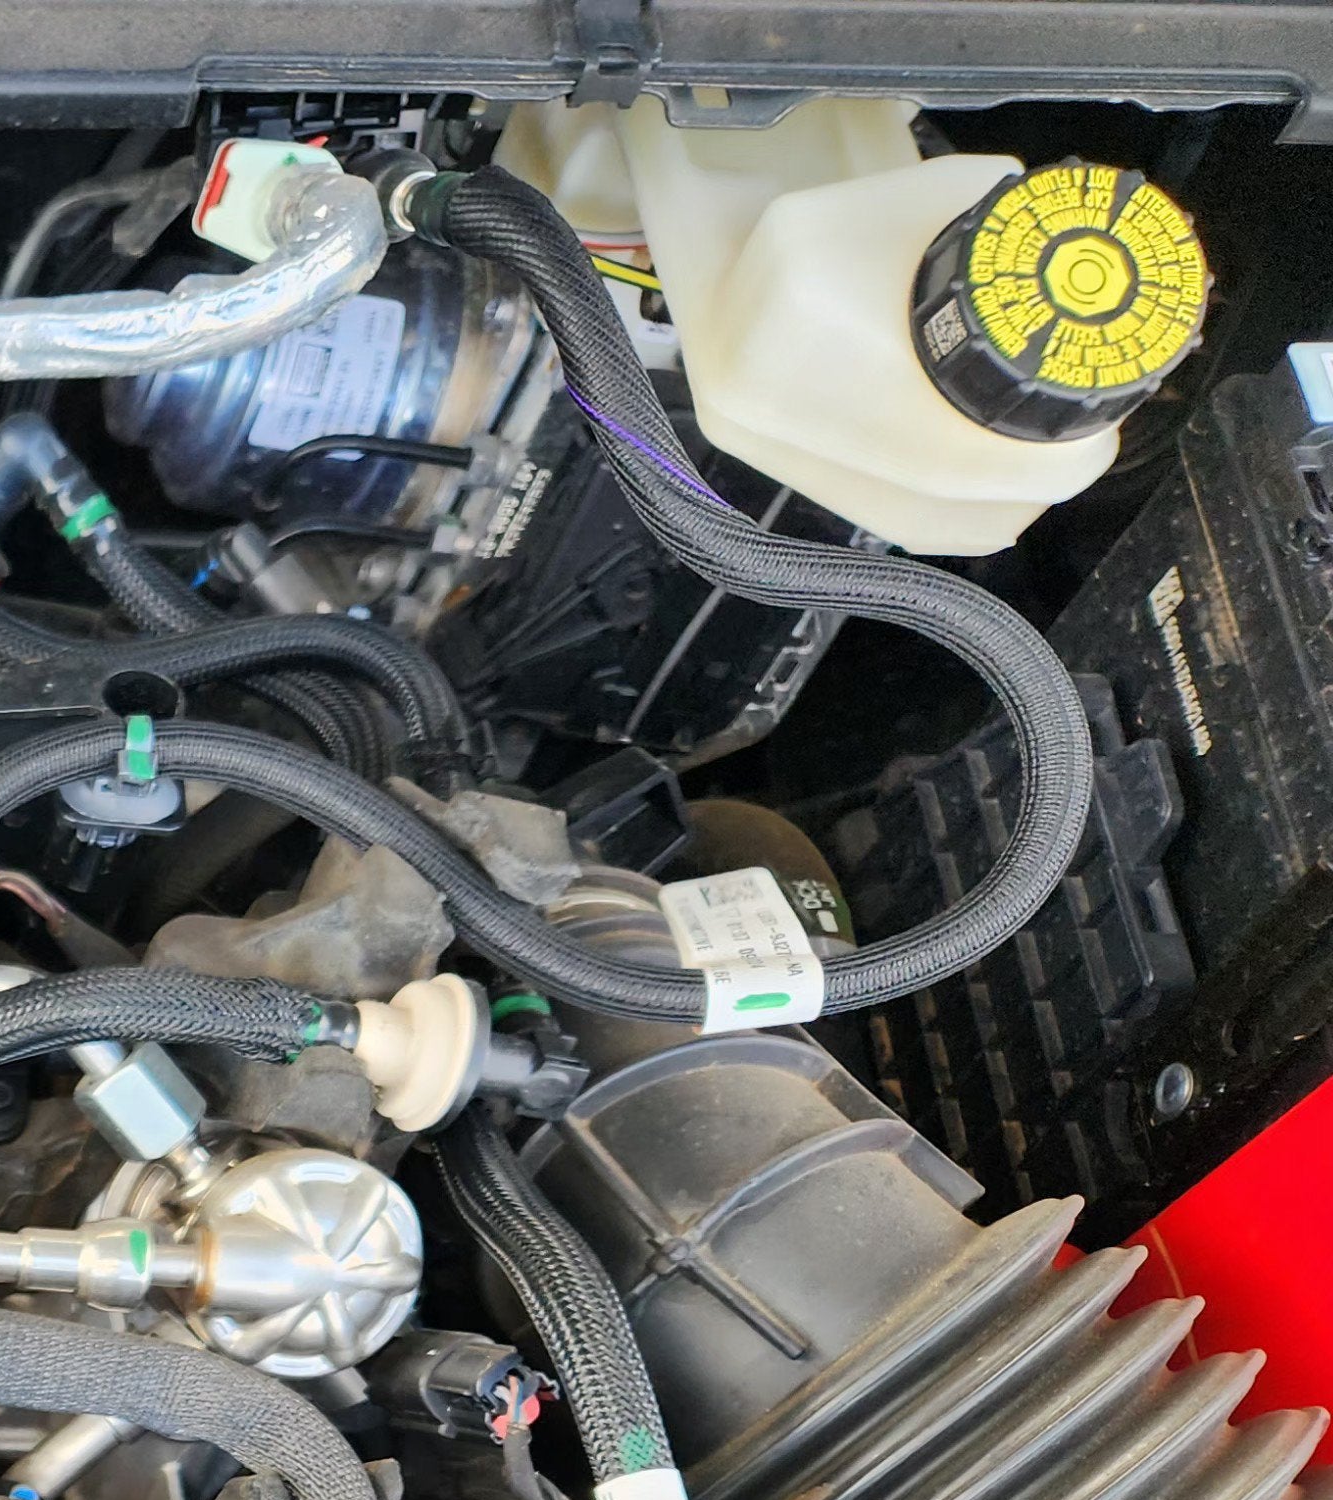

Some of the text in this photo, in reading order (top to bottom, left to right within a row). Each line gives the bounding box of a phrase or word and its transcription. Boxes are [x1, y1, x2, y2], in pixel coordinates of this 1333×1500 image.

[1026, 168, 1073, 199] FLUID
[1087, 167, 1118, 189] DOT
[992, 183, 1035, 222] FROM
[1084, 188, 1115, 210] CAP
[1129, 180, 1193, 242] ATTENTION
[968, 225, 1000, 285] SEALED
[1174, 239, 1202, 305] NETTOYER
[968, 285, 1025, 364] CONTAINER
[1171, 303, 1197, 325] LE
